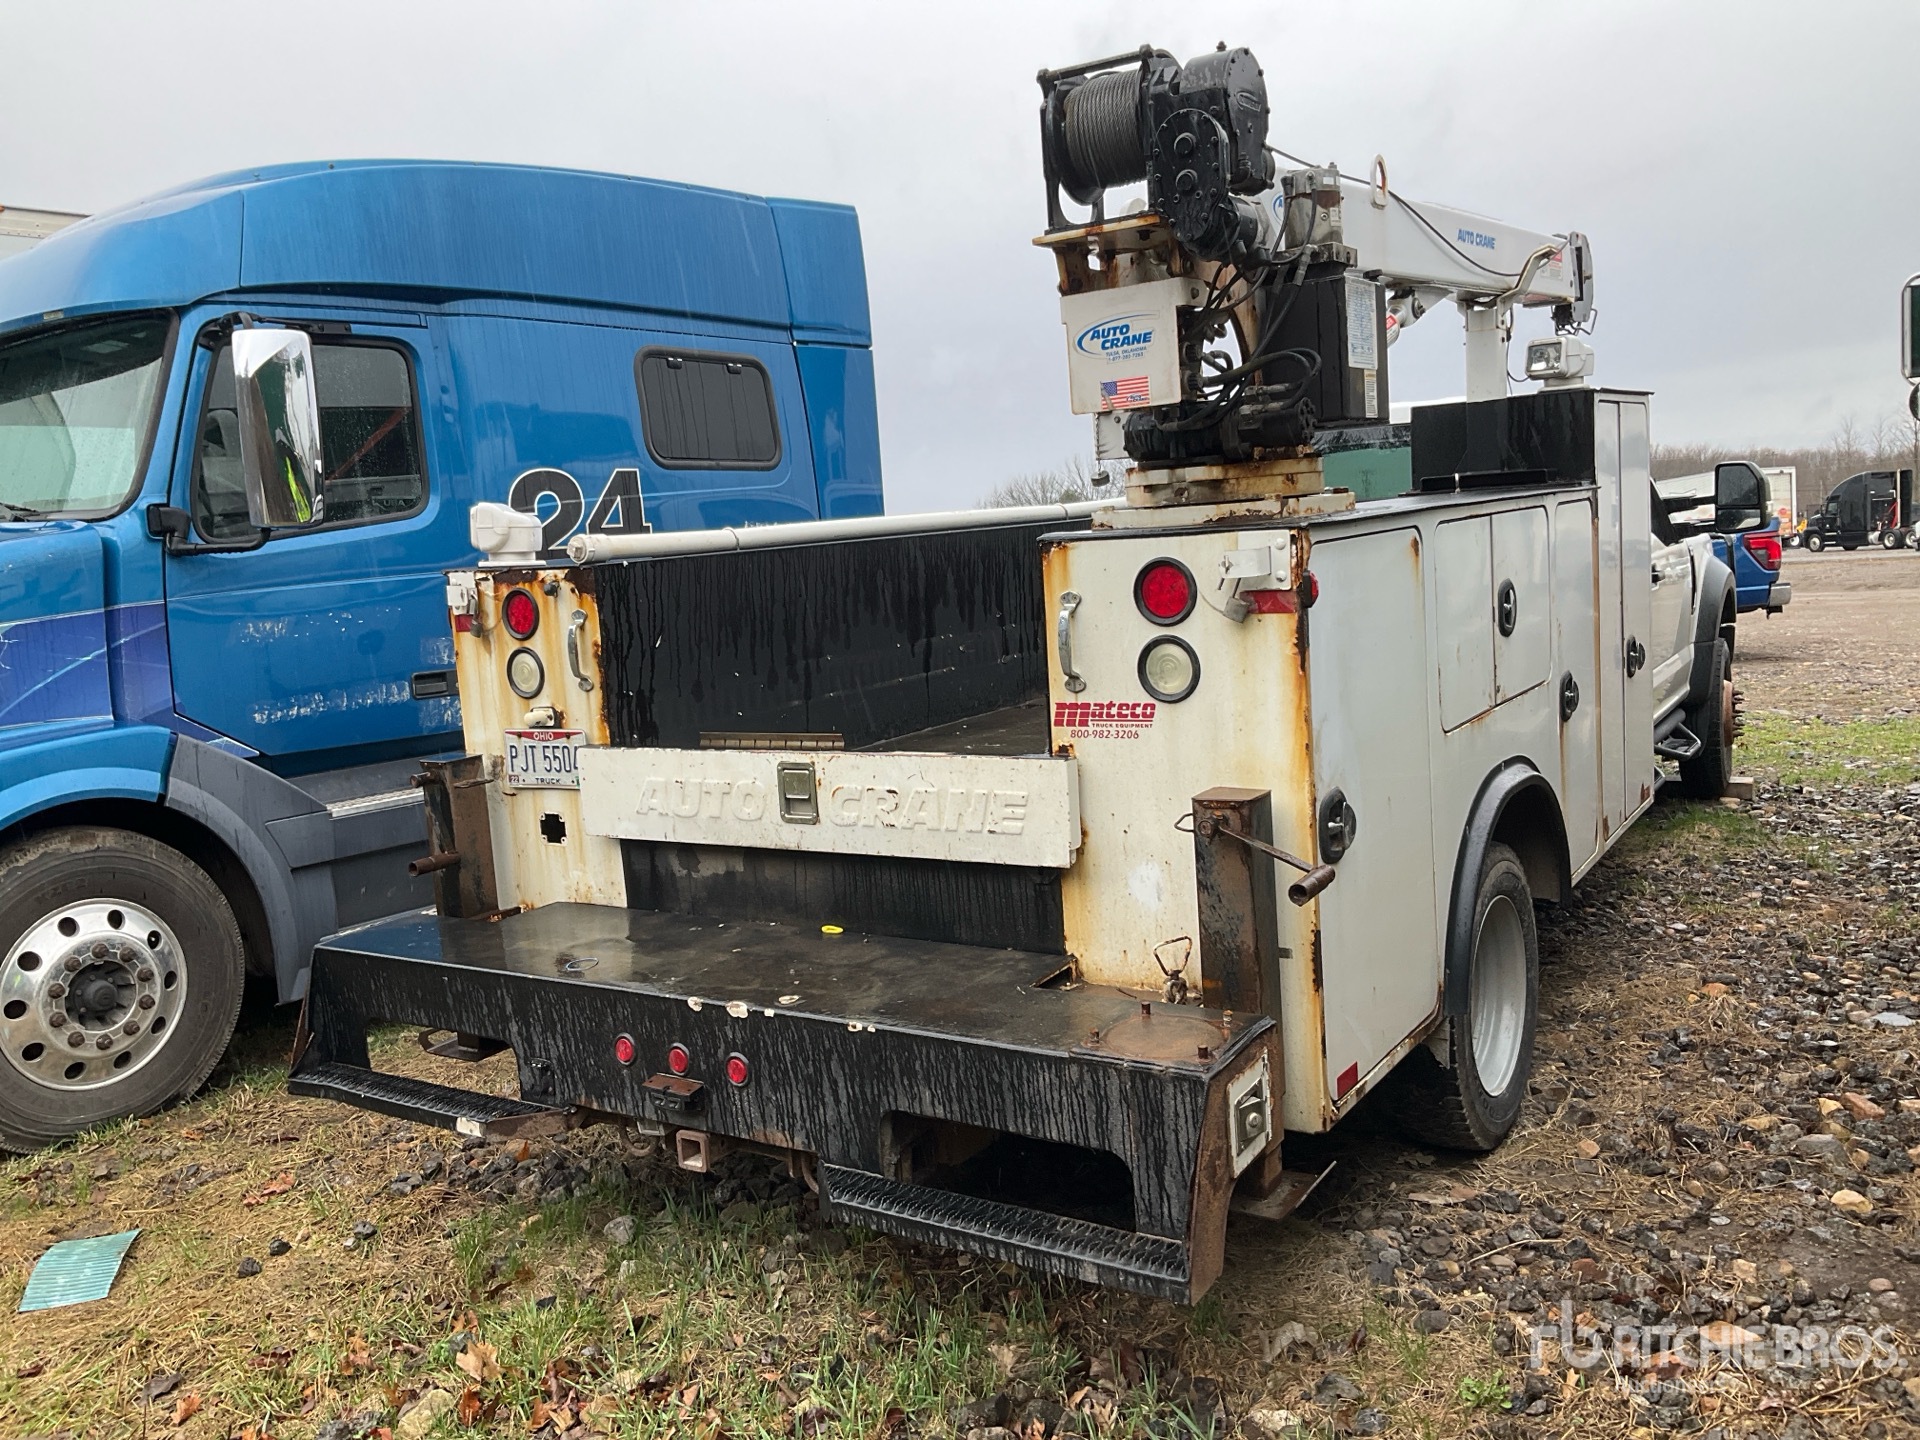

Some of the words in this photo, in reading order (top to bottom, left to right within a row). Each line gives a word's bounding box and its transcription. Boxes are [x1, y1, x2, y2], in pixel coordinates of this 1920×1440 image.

[1457, 229, 1475, 245] AUTO
[1476, 233, 1496, 250] CRANE
[1090, 323, 1130, 341] AUTO
[1101, 330, 1153, 351] CRANE
[508, 468, 653, 560] 24
[533, 731, 554, 741] OHIO
[1070, 729, 1140, 740] 800-982-3206
[509, 744, 537, 773] PJT
[535, 777, 560, 786] TRUCK
[636, 777, 767, 822] AUTO
[830, 784, 1029, 836] CRANE
